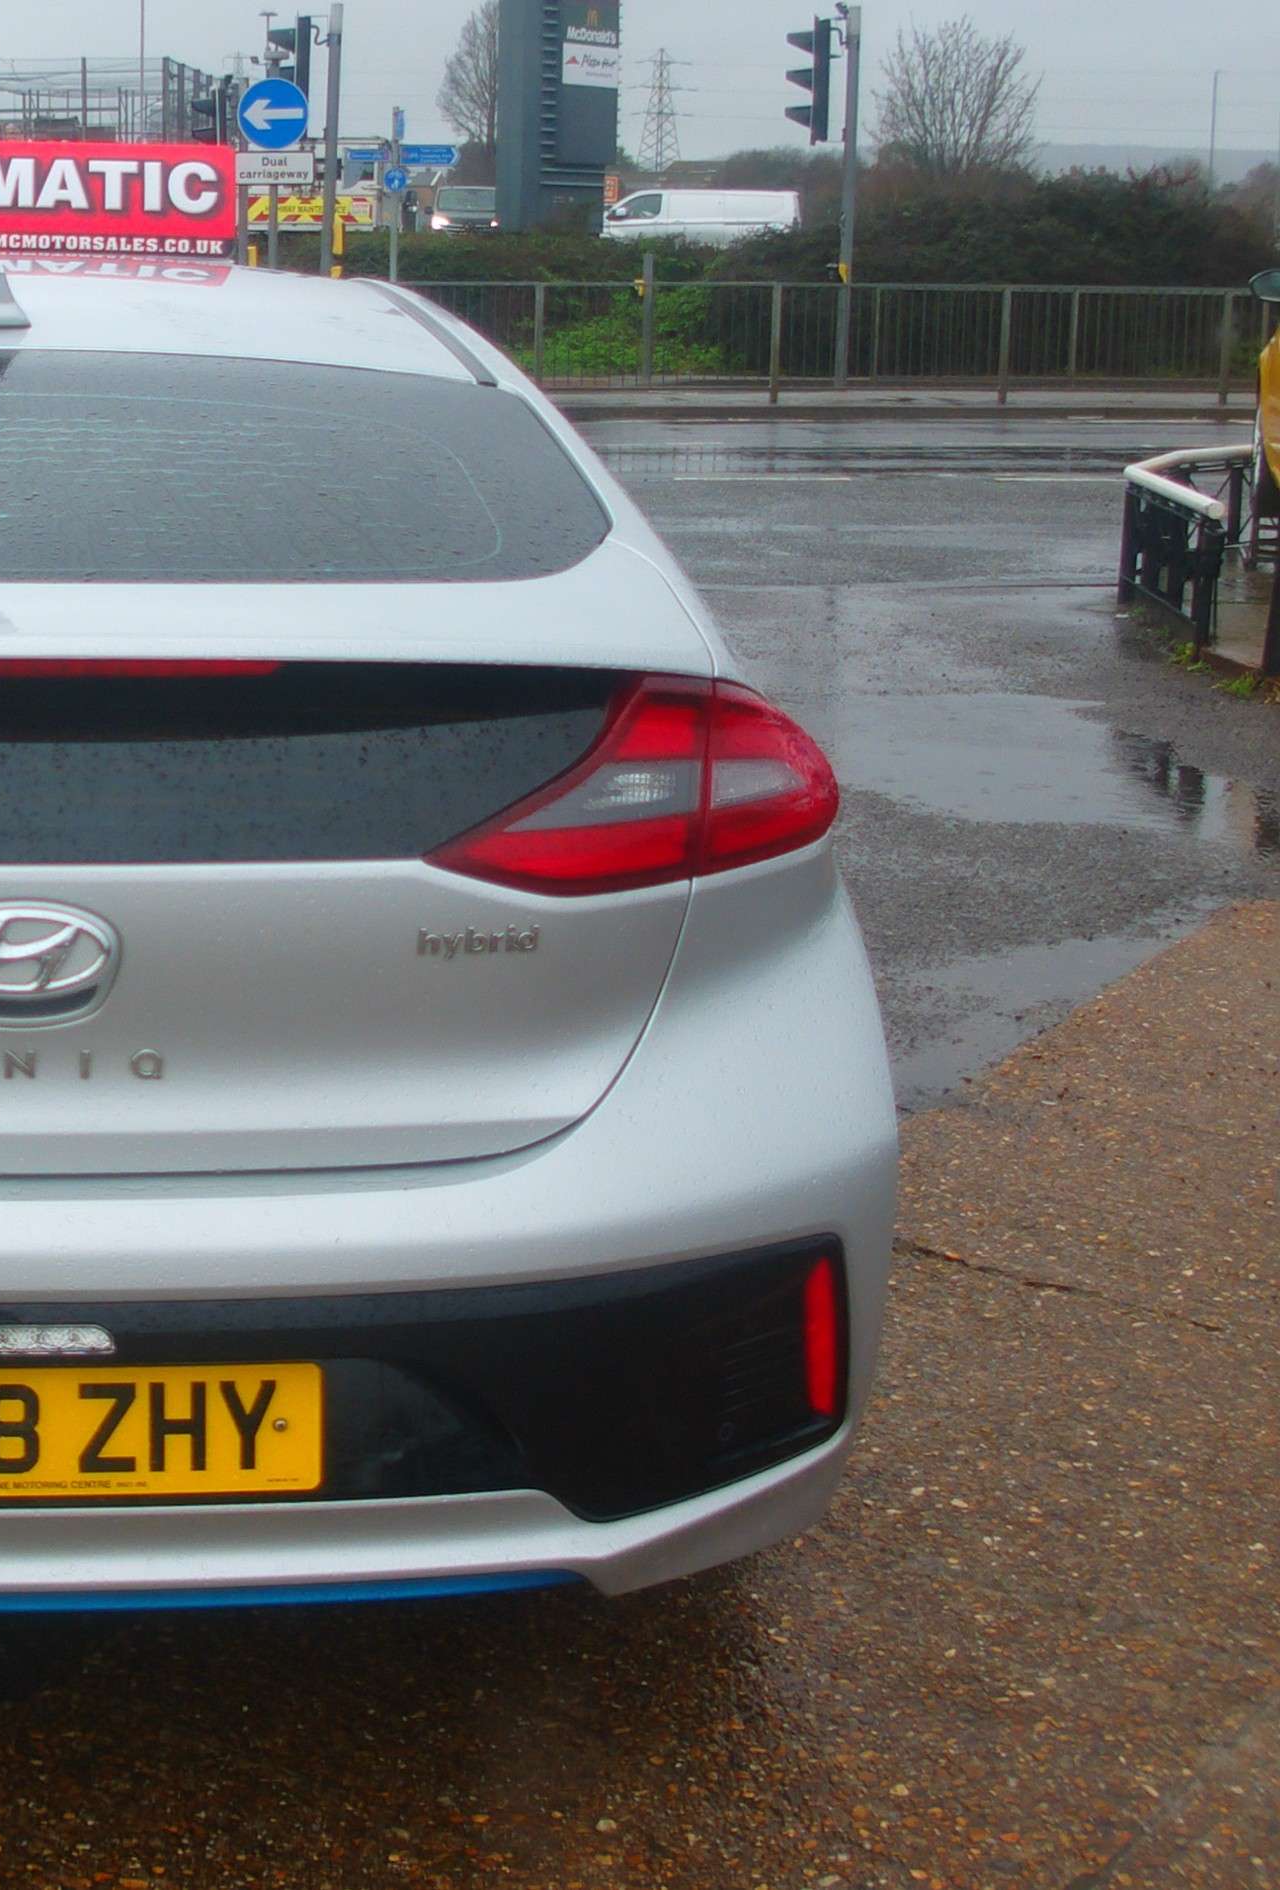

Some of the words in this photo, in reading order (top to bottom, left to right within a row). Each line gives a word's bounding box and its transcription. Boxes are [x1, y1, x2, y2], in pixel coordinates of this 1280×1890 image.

[261, 157, 288, 167] Dual
[239, 170, 309, 180] carriageway
[417, 923, 540, 960] hybrid
[78, 1380, 277, 1474] ZHY
[12, 1479, 68, 1490] MOTORING
[70, 1479, 112, 1489] CENTRE
